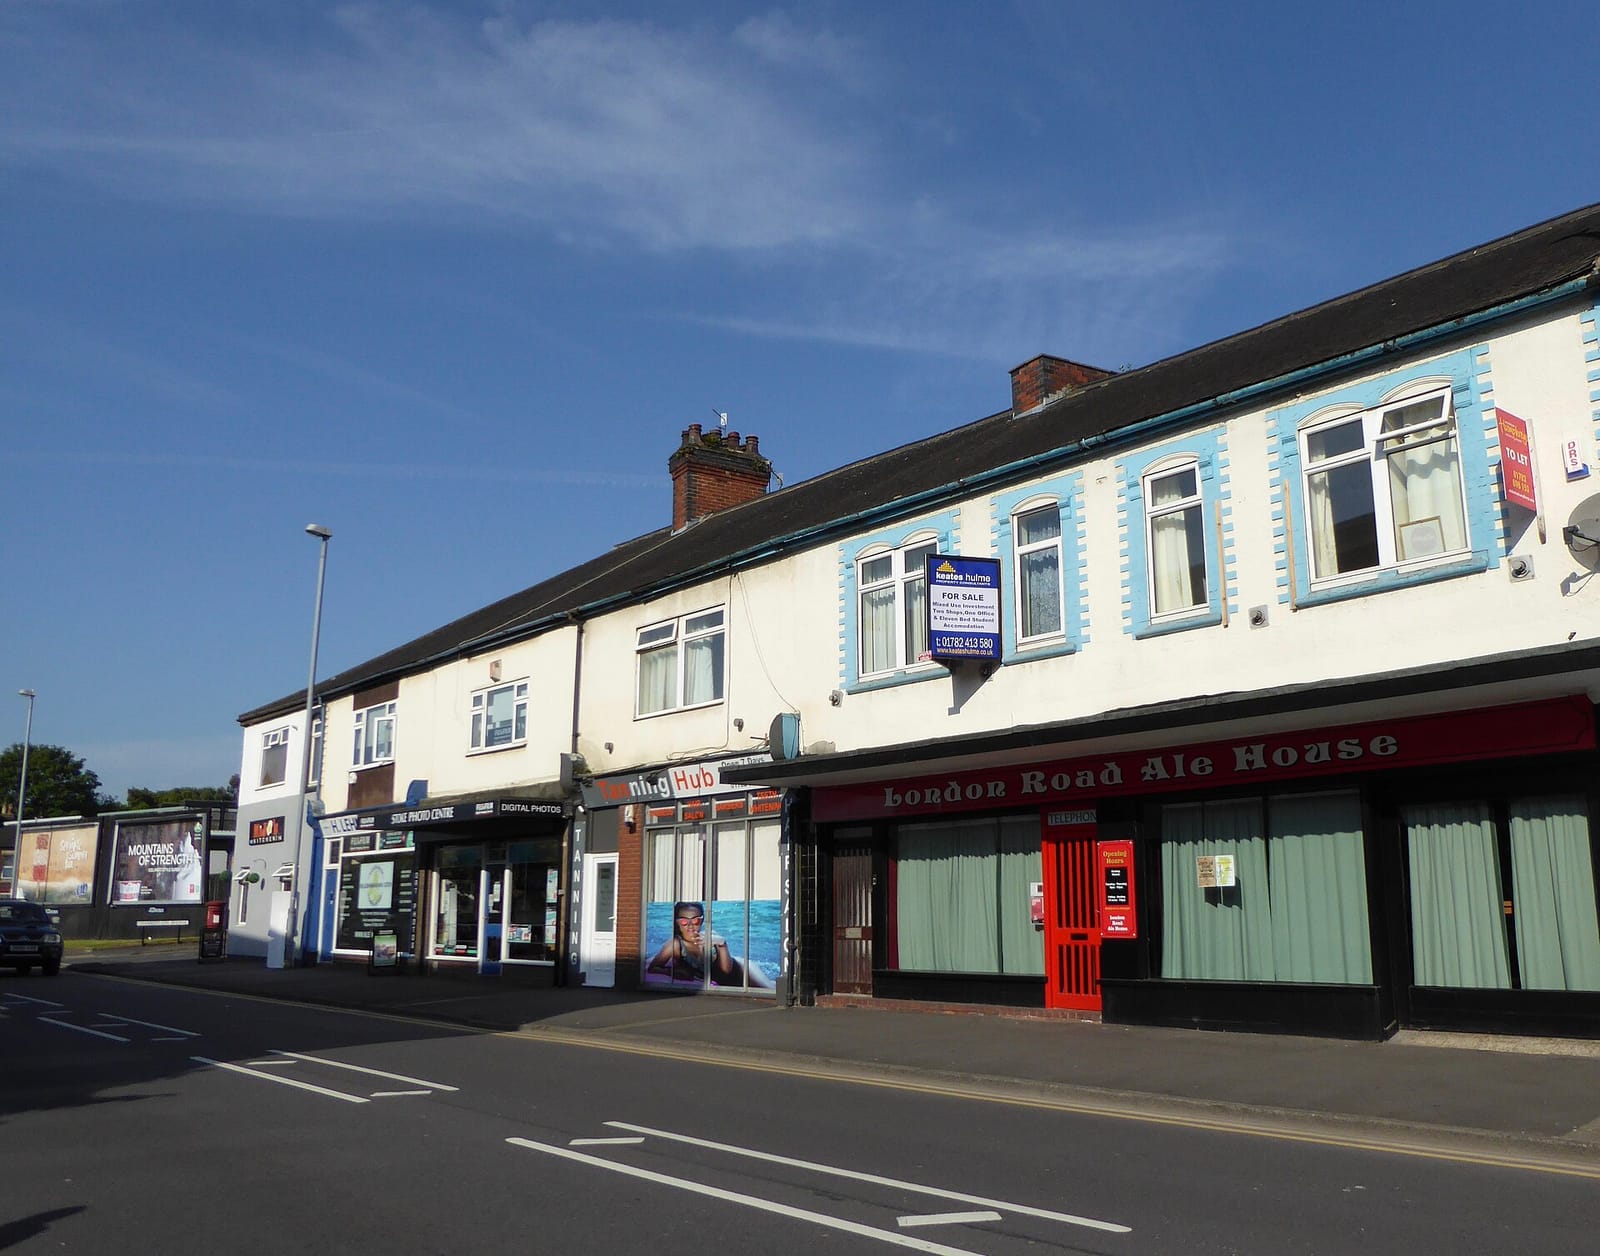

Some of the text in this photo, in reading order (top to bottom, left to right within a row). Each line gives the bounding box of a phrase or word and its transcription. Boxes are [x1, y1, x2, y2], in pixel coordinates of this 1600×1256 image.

[1505, 447, 1528, 466] TO LET
[1567, 441, 1578, 466] DRS
[936, 572, 991, 583] keates hulme
[942, 592, 984, 602] FOR SALE
[942, 637, 963, 648] 01782
[964, 637, 978, 648] 413
[979, 638, 993, 649] 580
[884, 735, 1398, 808] London Road Ale House
[597, 767, 715, 801] Tanning Hub
[408, 809, 430, 823] PHOTO
[431, 806, 454, 820] CENTRE
[501, 803, 562, 814] DIGITAL PHOTOS
[128, 843, 174, 857] MOUNTAINS
[1103, 850, 1127, 858] Opening
[138, 853, 193, 866] OF STRENGTH
[571, 828, 581, 965] TANNING
